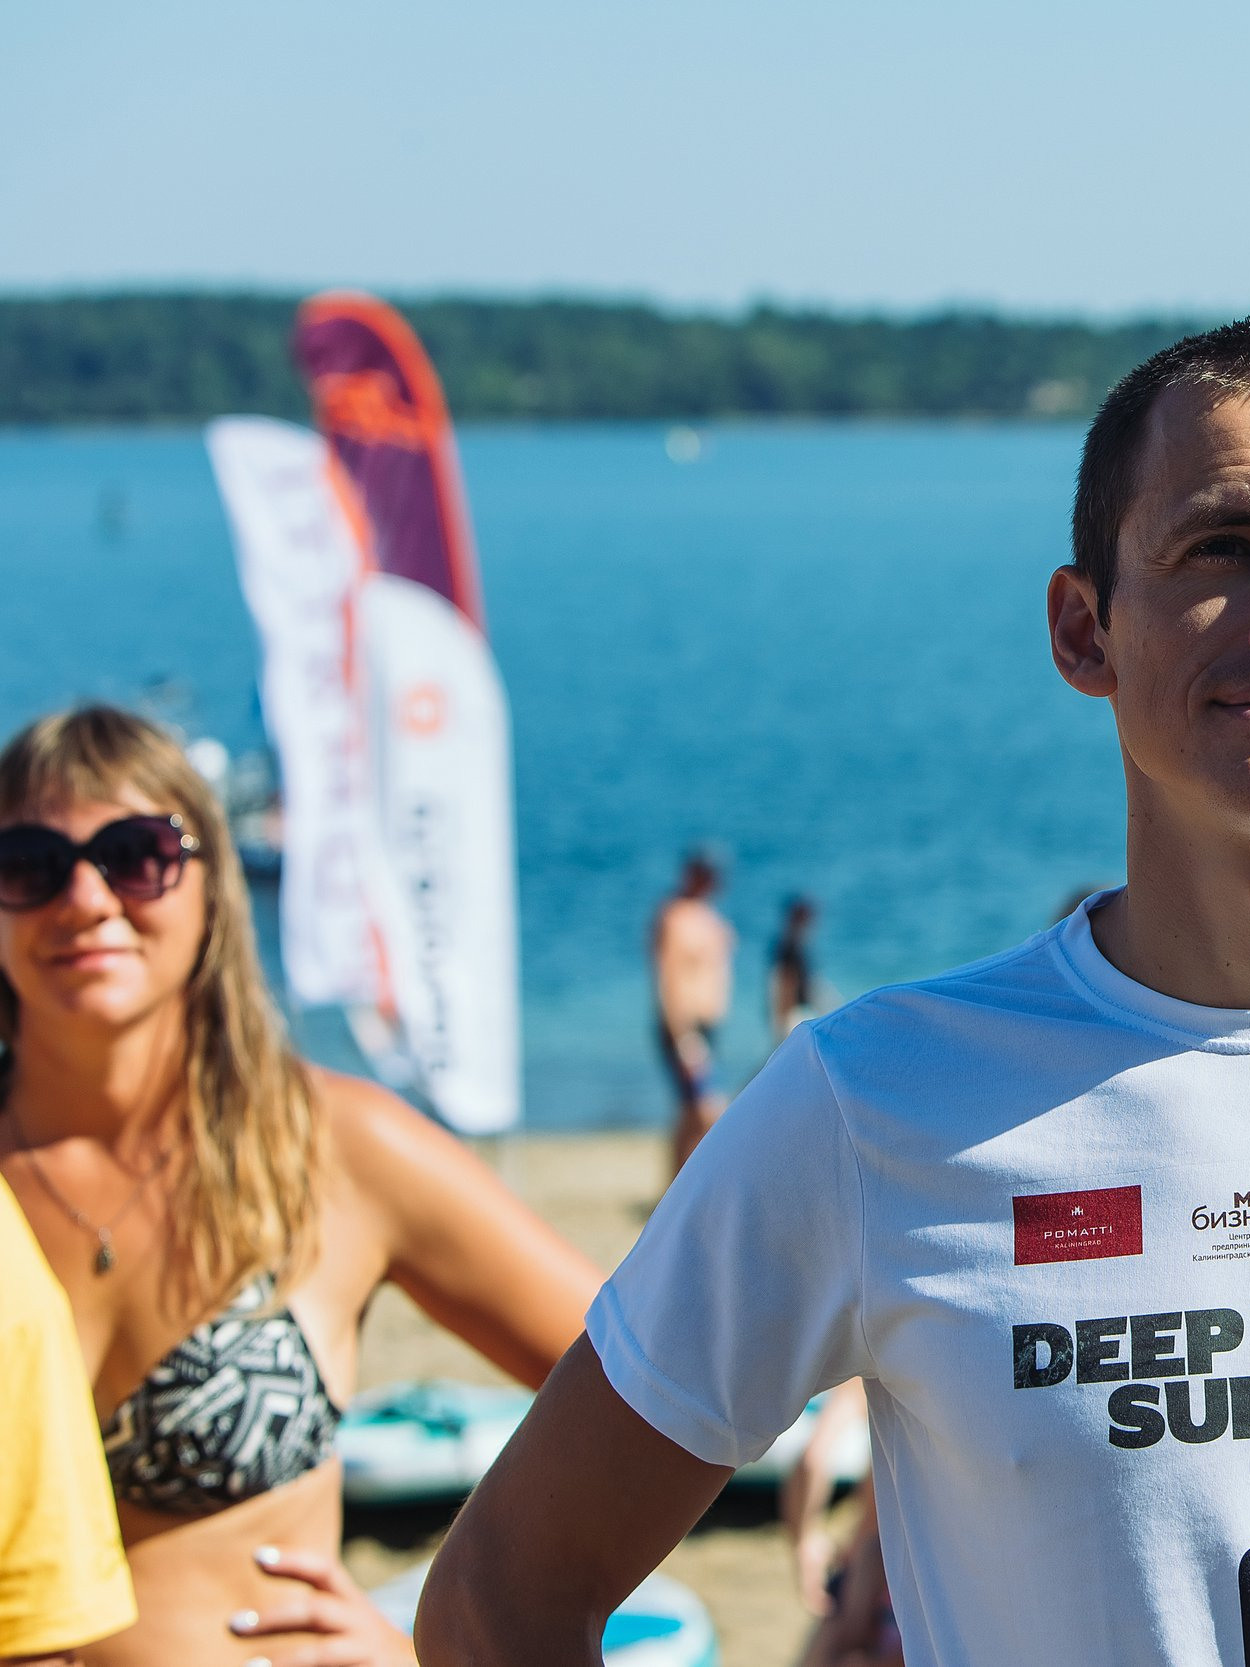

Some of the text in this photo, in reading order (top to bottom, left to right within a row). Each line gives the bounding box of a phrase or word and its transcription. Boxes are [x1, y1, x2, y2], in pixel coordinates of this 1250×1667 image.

[1044, 1225, 1113, 1239] POMATTI
[1228, 1231, 1250, 1241] Центр
[1054, 1239, 1102, 1249] KALININGRAD
[1012, 1307, 1244, 1389] DEEP
